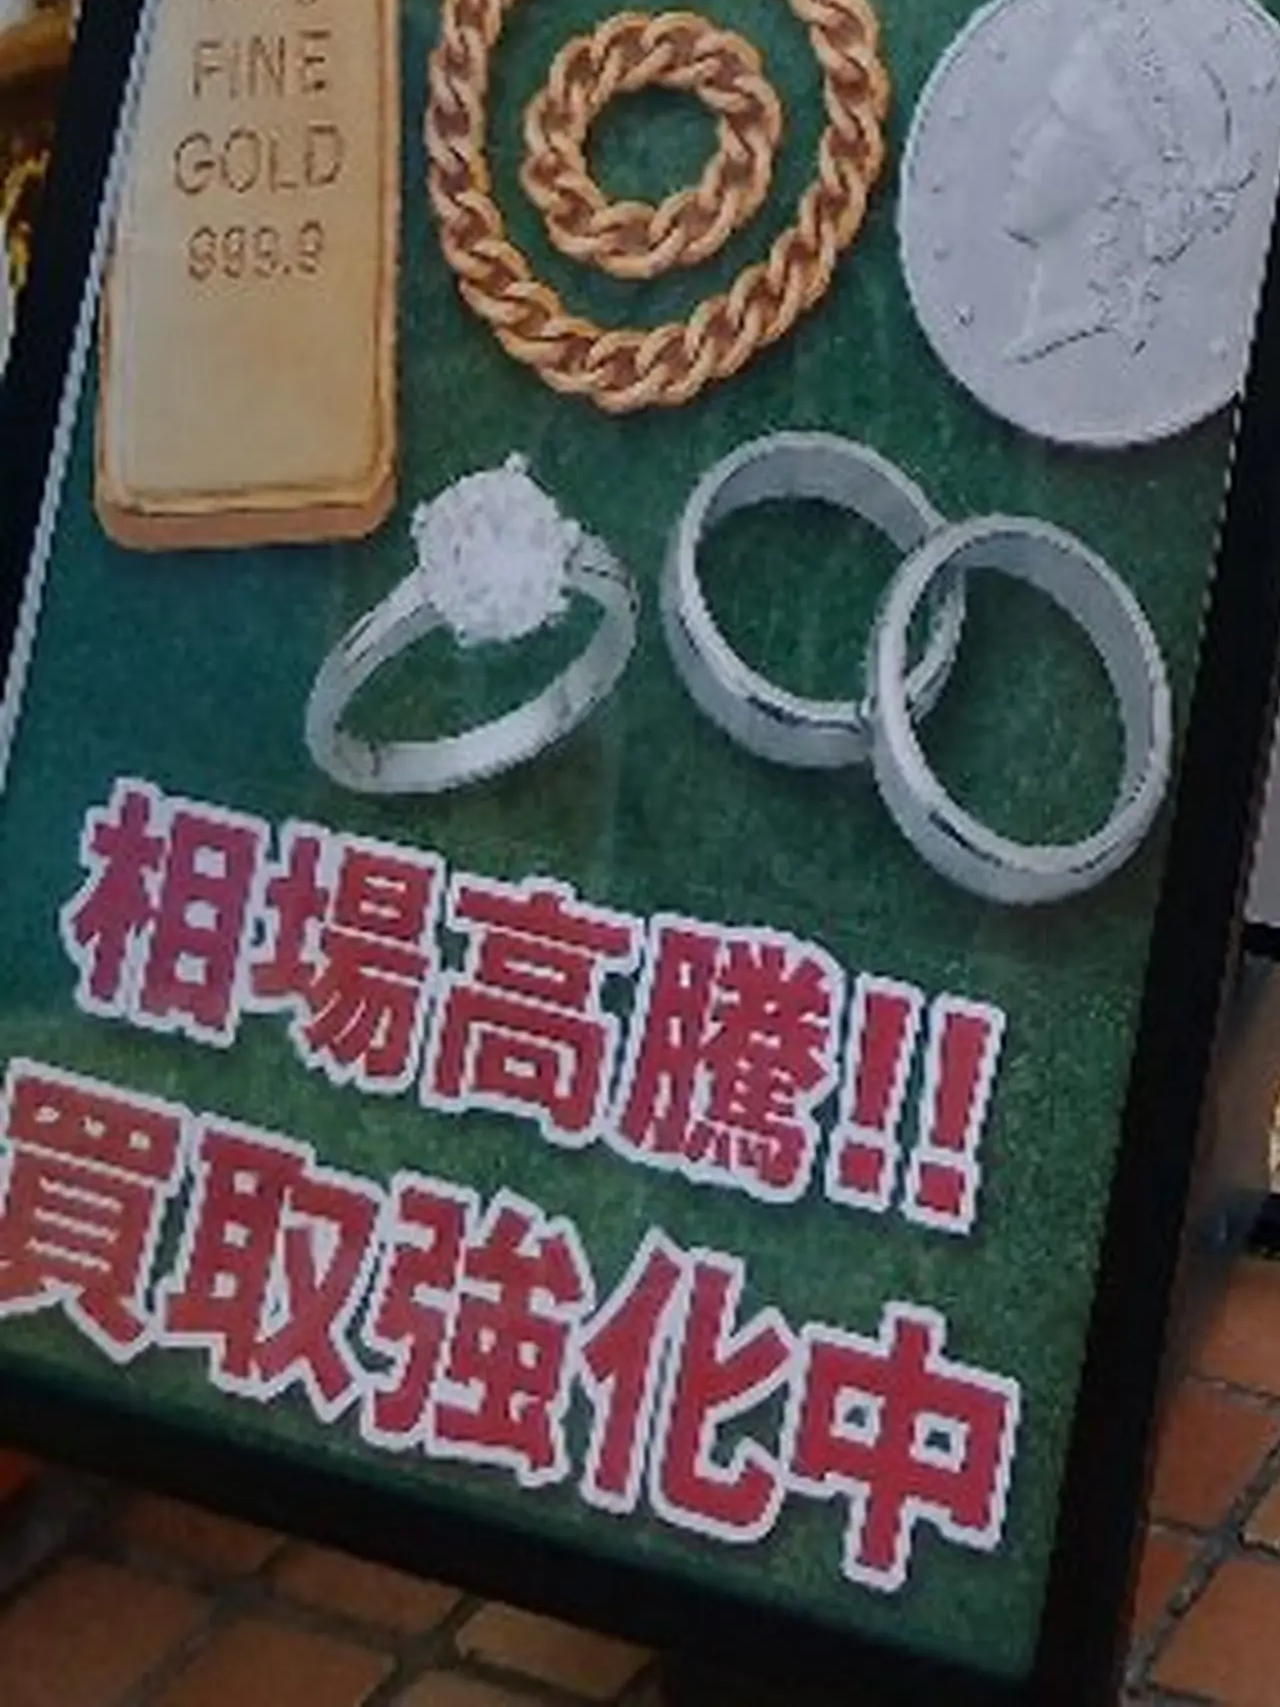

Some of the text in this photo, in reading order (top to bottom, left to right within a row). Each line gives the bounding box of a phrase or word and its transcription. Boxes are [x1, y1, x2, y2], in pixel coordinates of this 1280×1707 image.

[191, 30, 335, 100] FINE
[173, 124, 346, 196] GOLD
[186, 219, 327, 283] 999.9
[60, 777, 1005, 1234] 相場高騰!!
[0, 1056, 1021, 1592] 買取強化中
